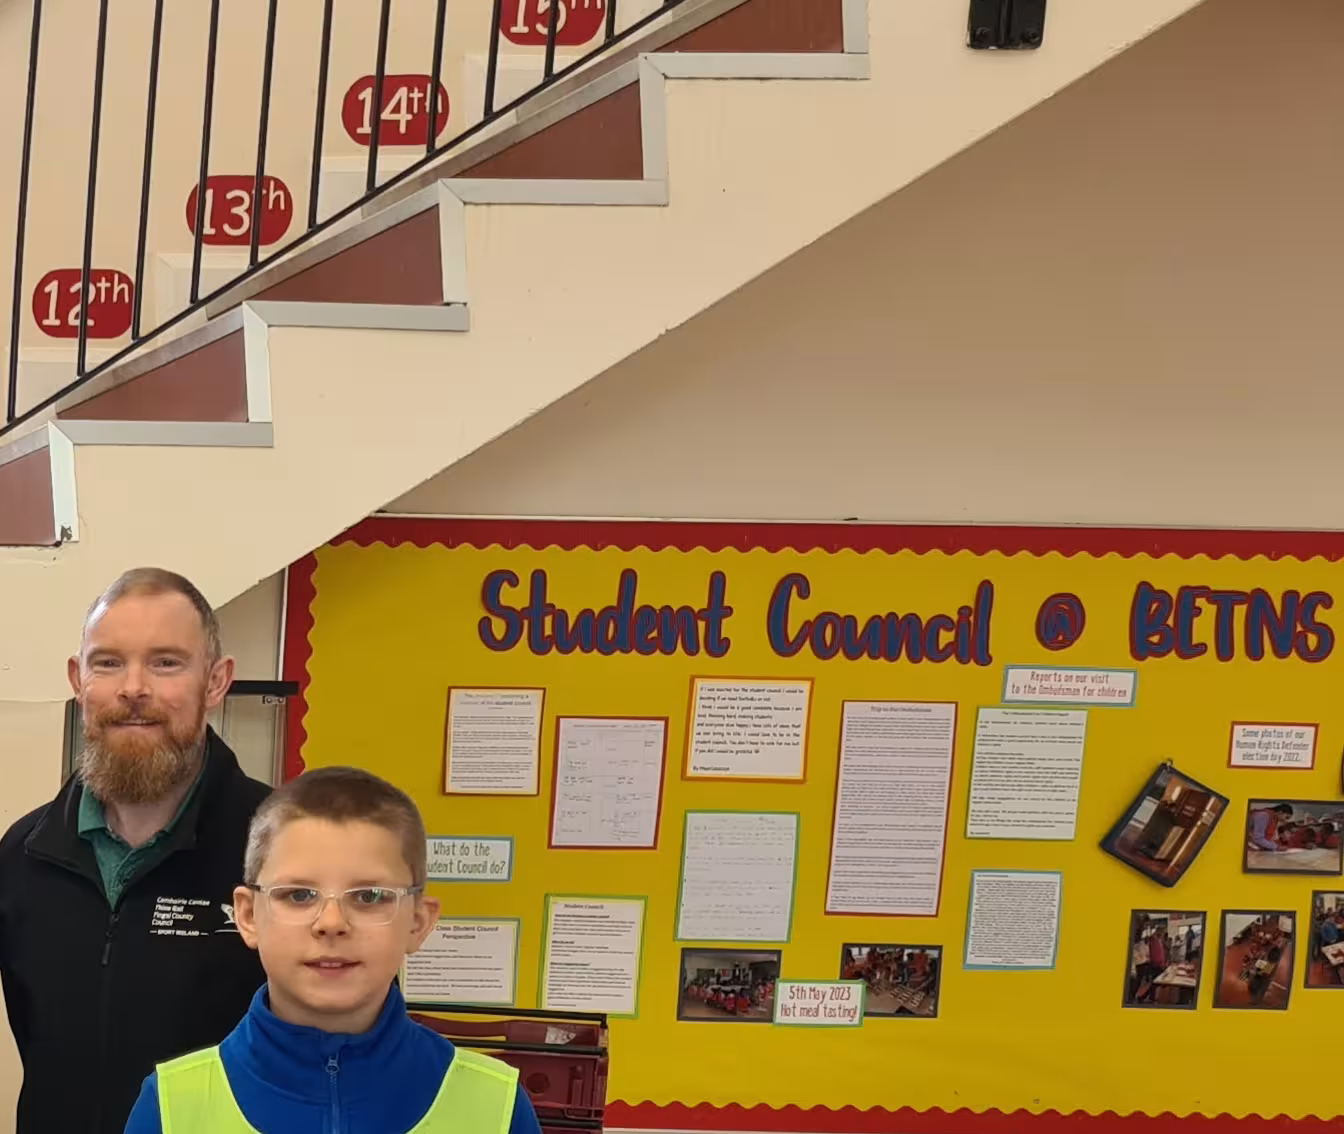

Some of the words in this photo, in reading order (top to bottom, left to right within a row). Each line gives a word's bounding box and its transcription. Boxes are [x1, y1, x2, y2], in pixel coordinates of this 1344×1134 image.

[510, 0, 602, 36] 15
[41, 273, 130, 327] 12th
[478, 568, 733, 658] Student
[766, 572, 994, 667] Council
[1032, 592, 1086, 650] @
[1129, 581, 1336, 663] BETNS
[1030, 671, 1062, 683] Reports
[1091, 673, 1109, 684] visit
[1011, 683, 1020, 694] to
[1023, 684, 1037, 695] the
[1083, 686, 1095, 697] for
[433, 841, 456, 857] What
[459, 842, 470, 857] do
[474, 842, 491, 857] the
[427, 859, 454, 874] udent
[457, 859, 487, 874] Council
[490, 860, 506, 874] do?
[172, 912, 194, 921] County
[788, 985, 807, 1001] 5th
[808, 986, 827, 1004] May
[829, 986, 852, 1001] 2023
[780, 1003, 797, 1018] Hot
[799, 1004, 820, 1018] meal
